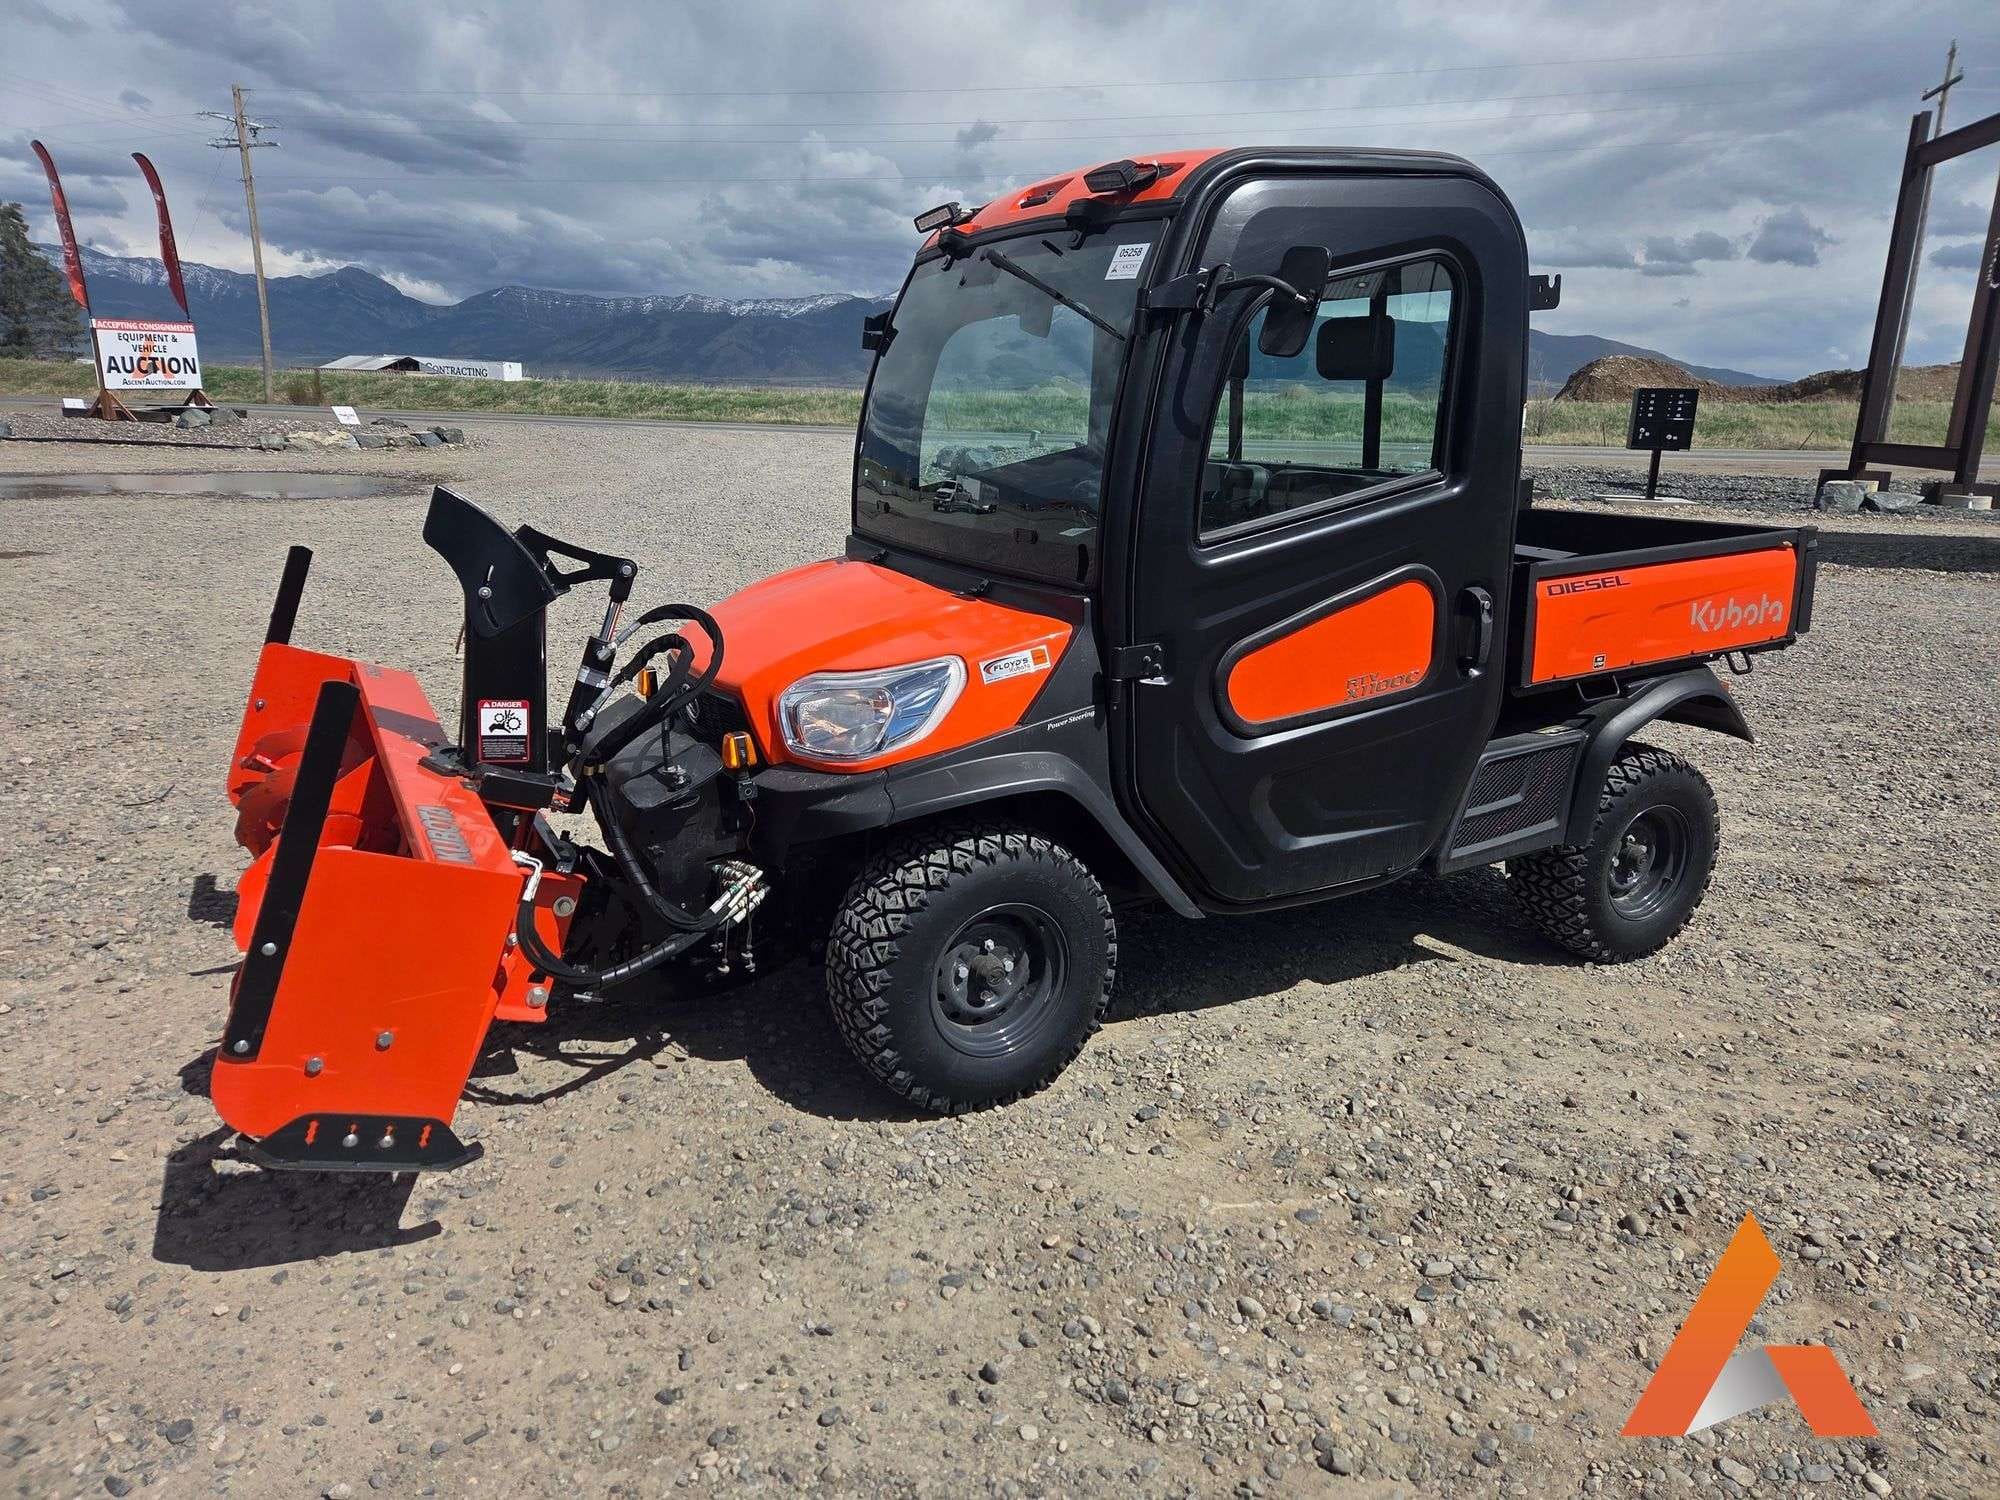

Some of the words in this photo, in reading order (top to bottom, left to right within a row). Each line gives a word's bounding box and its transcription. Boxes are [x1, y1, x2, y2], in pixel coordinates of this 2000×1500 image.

[1120, 248, 1143, 257] 05258
[97, 321, 137, 330] ACCEPTING
[139, 322, 194, 332] CONSIGNMENTS
[118, 333, 169, 342] EQUIPMENT
[171, 335, 178, 343] &
[132, 344, 168, 353] VEHICLE
[107, 356, 197, 374] AUCTION
[1546, 575, 1631, 597] DIESEL
[1689, 593, 1785, 633] Kubota
[994, 657, 1029, 672] FLOYD'S
[1047, 719, 1068, 731] Power
[1068, 710, 1095, 724] Steering
